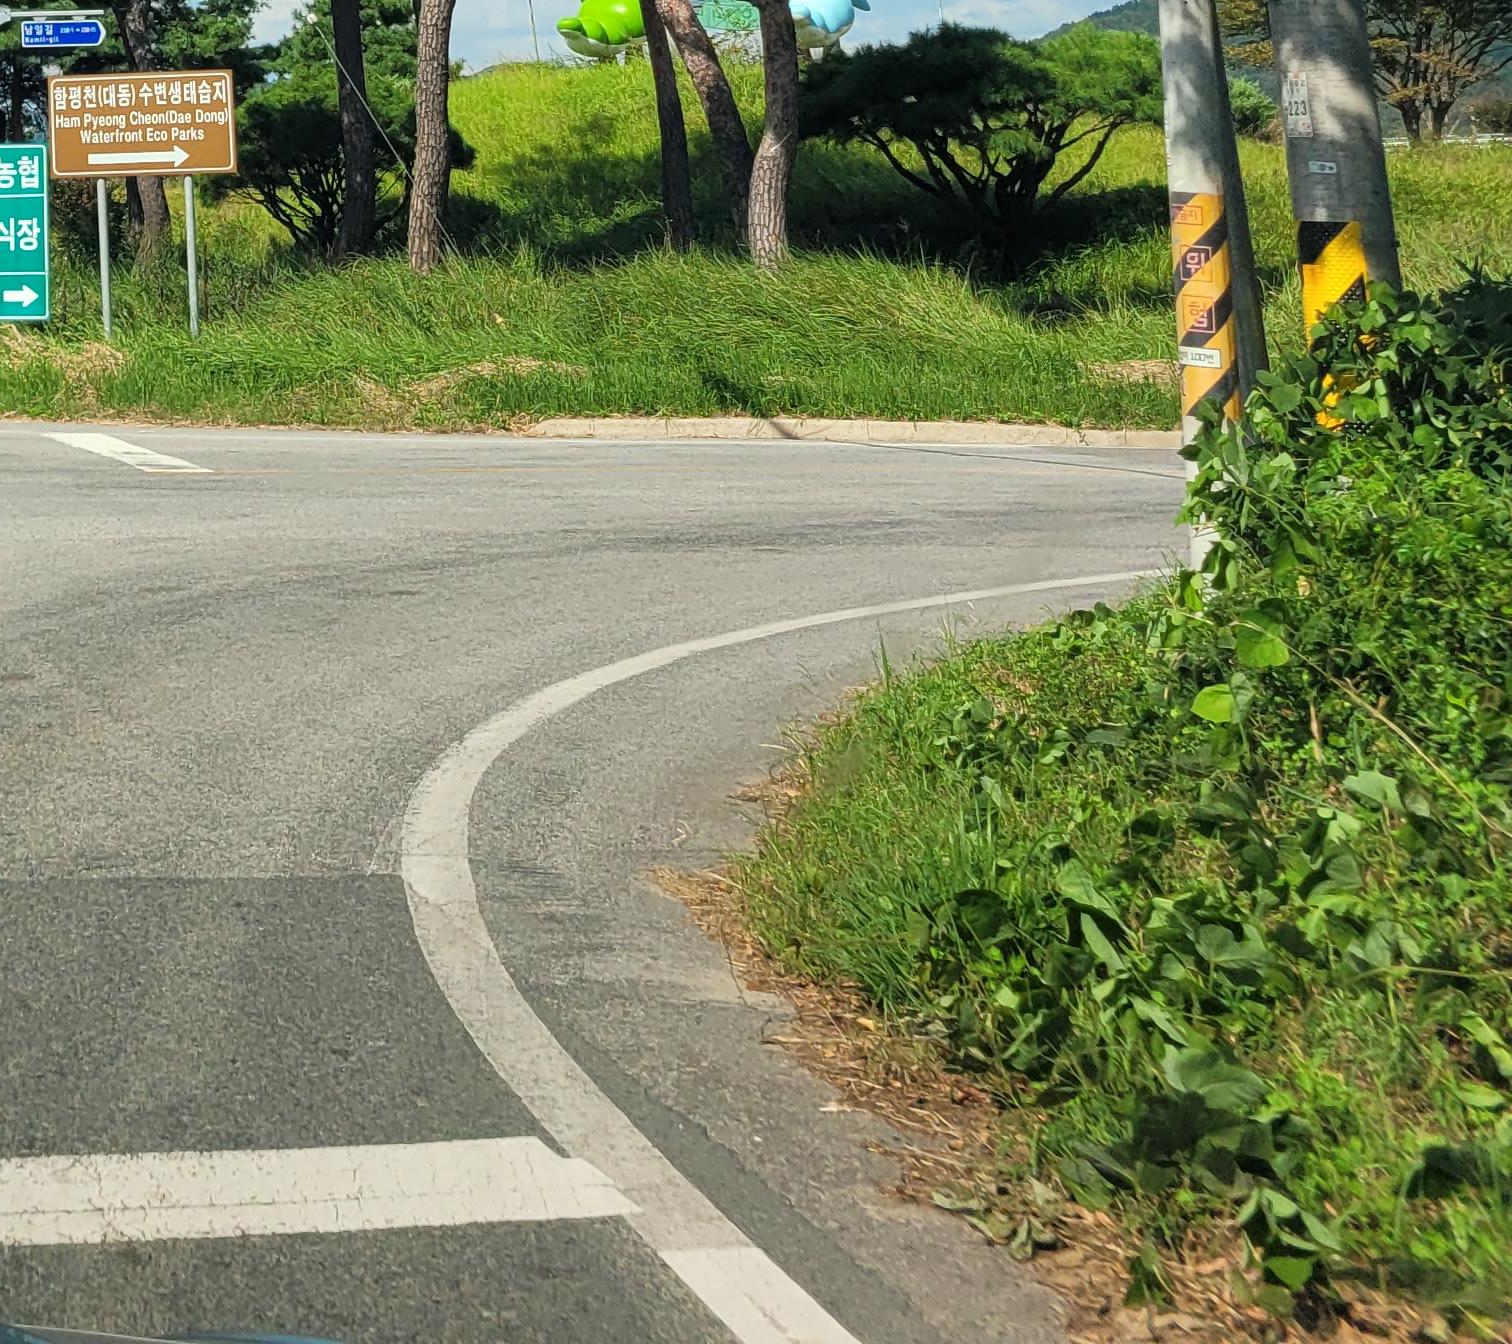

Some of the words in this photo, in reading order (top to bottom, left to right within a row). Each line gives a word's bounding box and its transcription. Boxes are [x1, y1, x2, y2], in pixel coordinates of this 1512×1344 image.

[54, 83, 136, 111] 함평천(대동)
[139, 79, 227, 107] 수변생태습지
[55, 114, 81, 129] Ham
[84, 113, 126, 130] Pyeong
[130, 109, 192, 127] Cheon(Dae
[196, 107, 229, 126] Dong)
[80, 128, 143, 144] Waterfront
[147, 127, 168, 142] Eco
[172, 126, 205, 141] Parks
